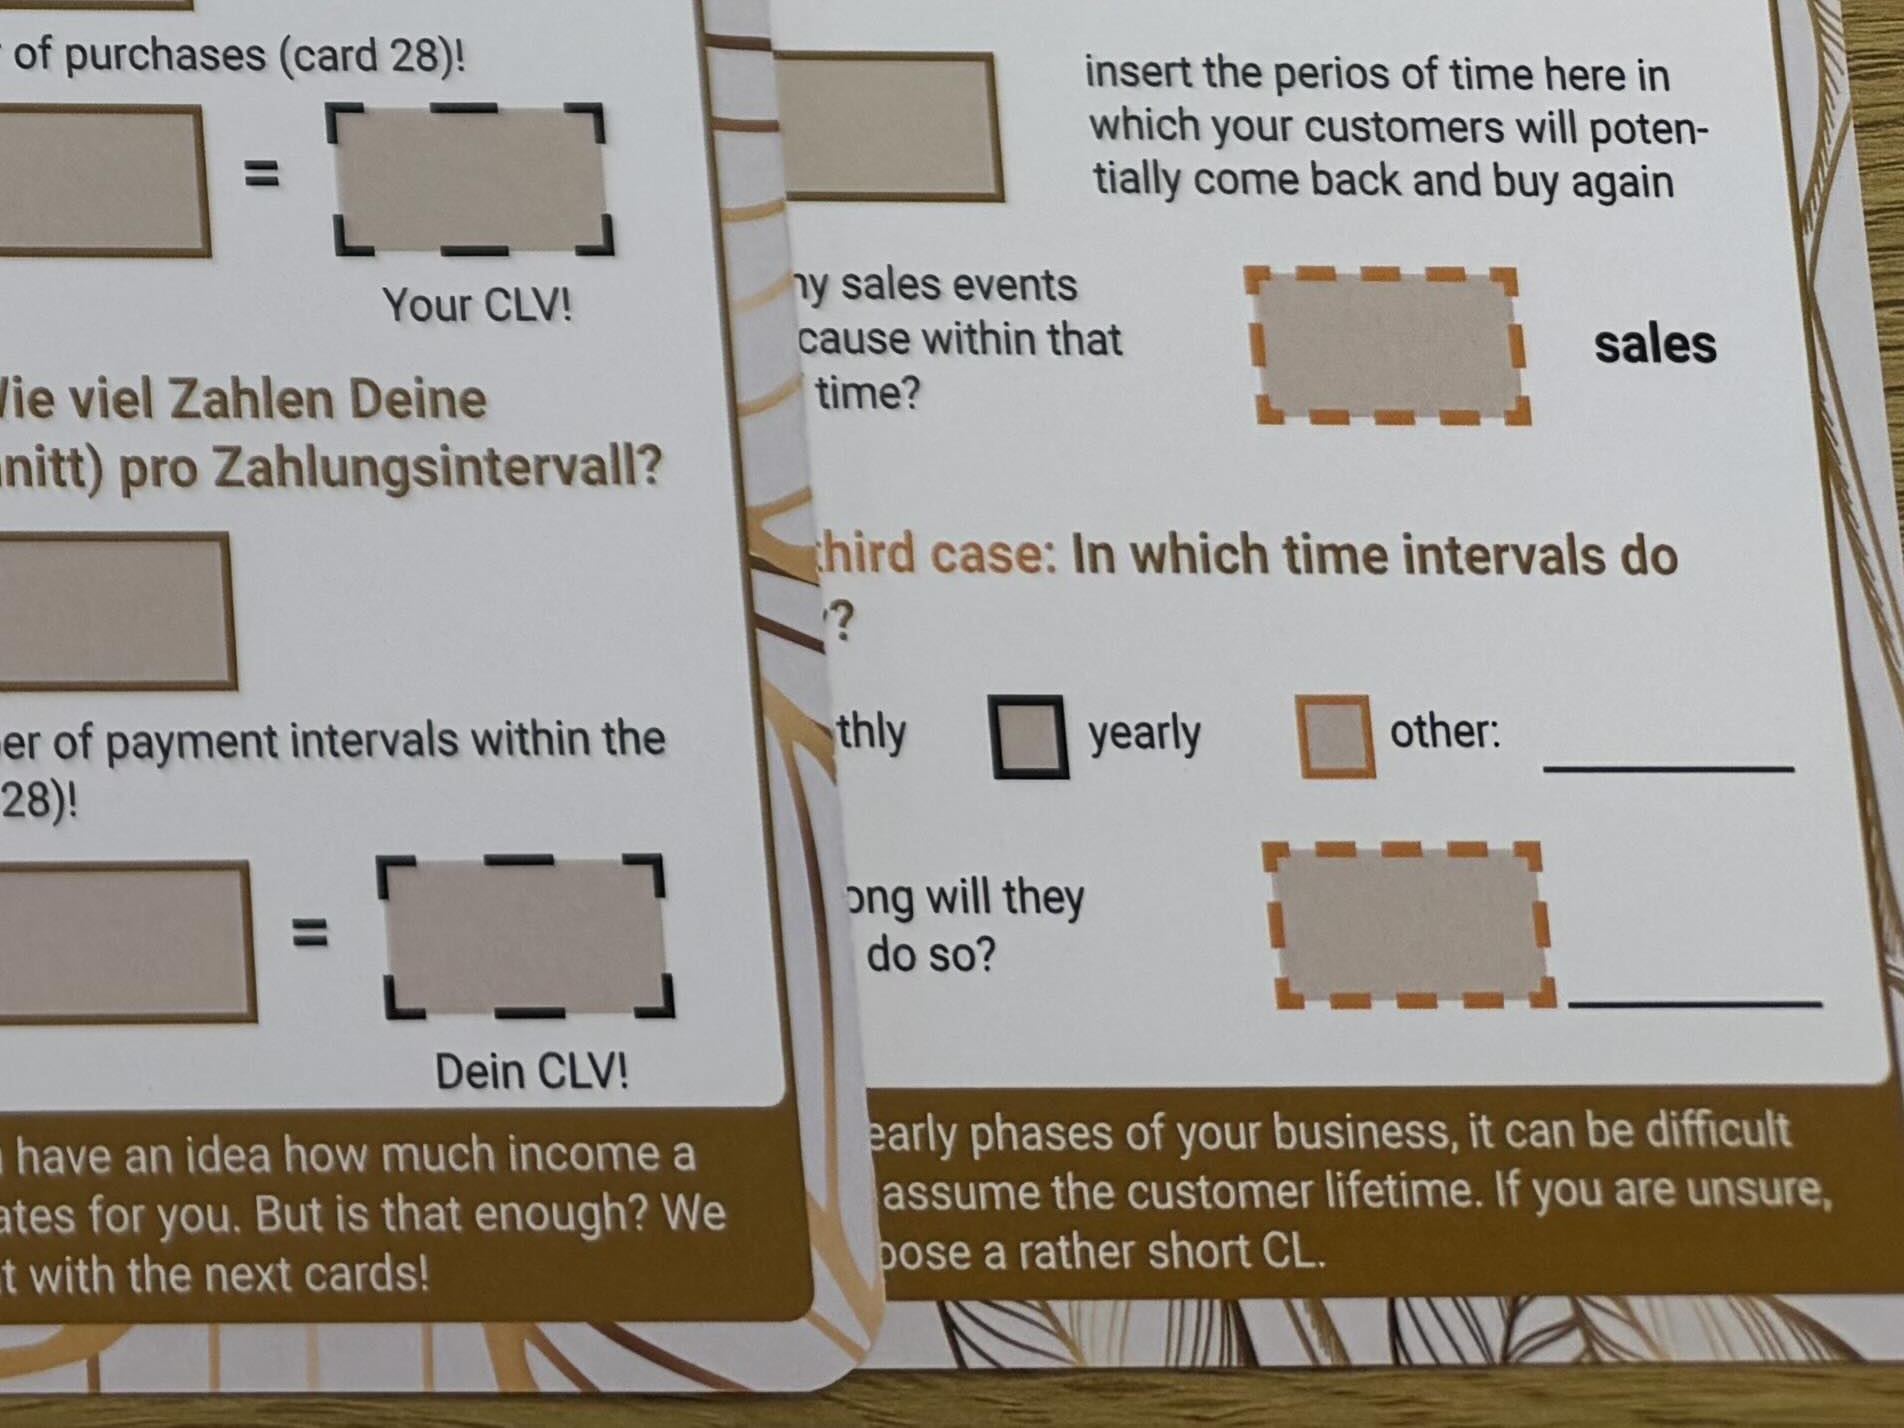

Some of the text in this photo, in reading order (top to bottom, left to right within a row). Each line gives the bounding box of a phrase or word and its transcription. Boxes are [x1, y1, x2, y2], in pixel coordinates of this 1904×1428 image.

[381, 286, 571, 323] Your CLV!
[1595, 319, 1718, 364] sales
[68, 374, 153, 420] viel
[168, 375, 334, 420] Zahlen
[350, 375, 487, 420] Deine
[1087, 711, 1202, 760] yearly
[1390, 710, 1500, 749] other:
[983, 1229, 1326, 1271] a rather short CL.
[29, 1253, 115, 1295] with
[126, 1253, 192, 1294] the
[205, 1257, 293, 1293] next
[305, 1251, 429, 1292] cards!
